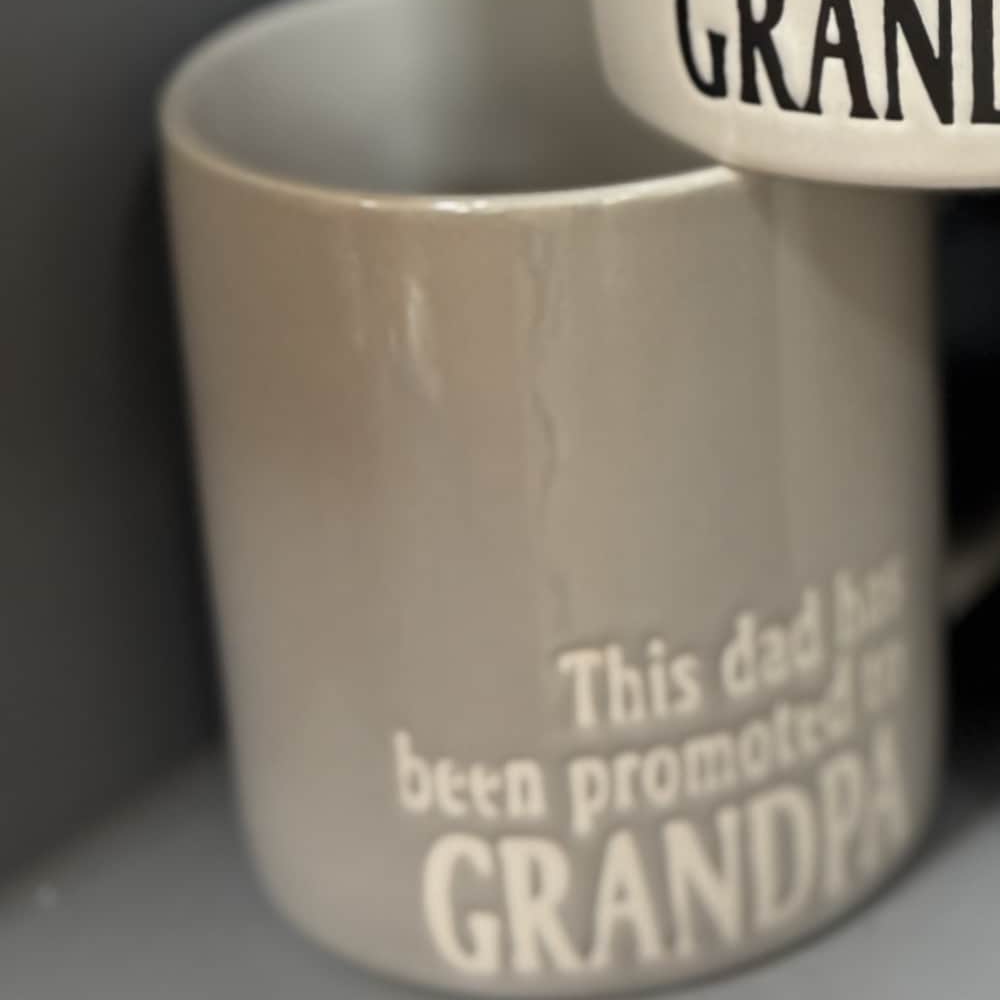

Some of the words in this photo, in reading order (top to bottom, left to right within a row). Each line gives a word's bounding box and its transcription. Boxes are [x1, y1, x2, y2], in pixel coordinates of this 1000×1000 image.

[557, 637, 701, 730] This
[720, 584, 822, 697] dad
[394, 730, 548, 819] been
[422, 722, 908, 976] GRANDPA
